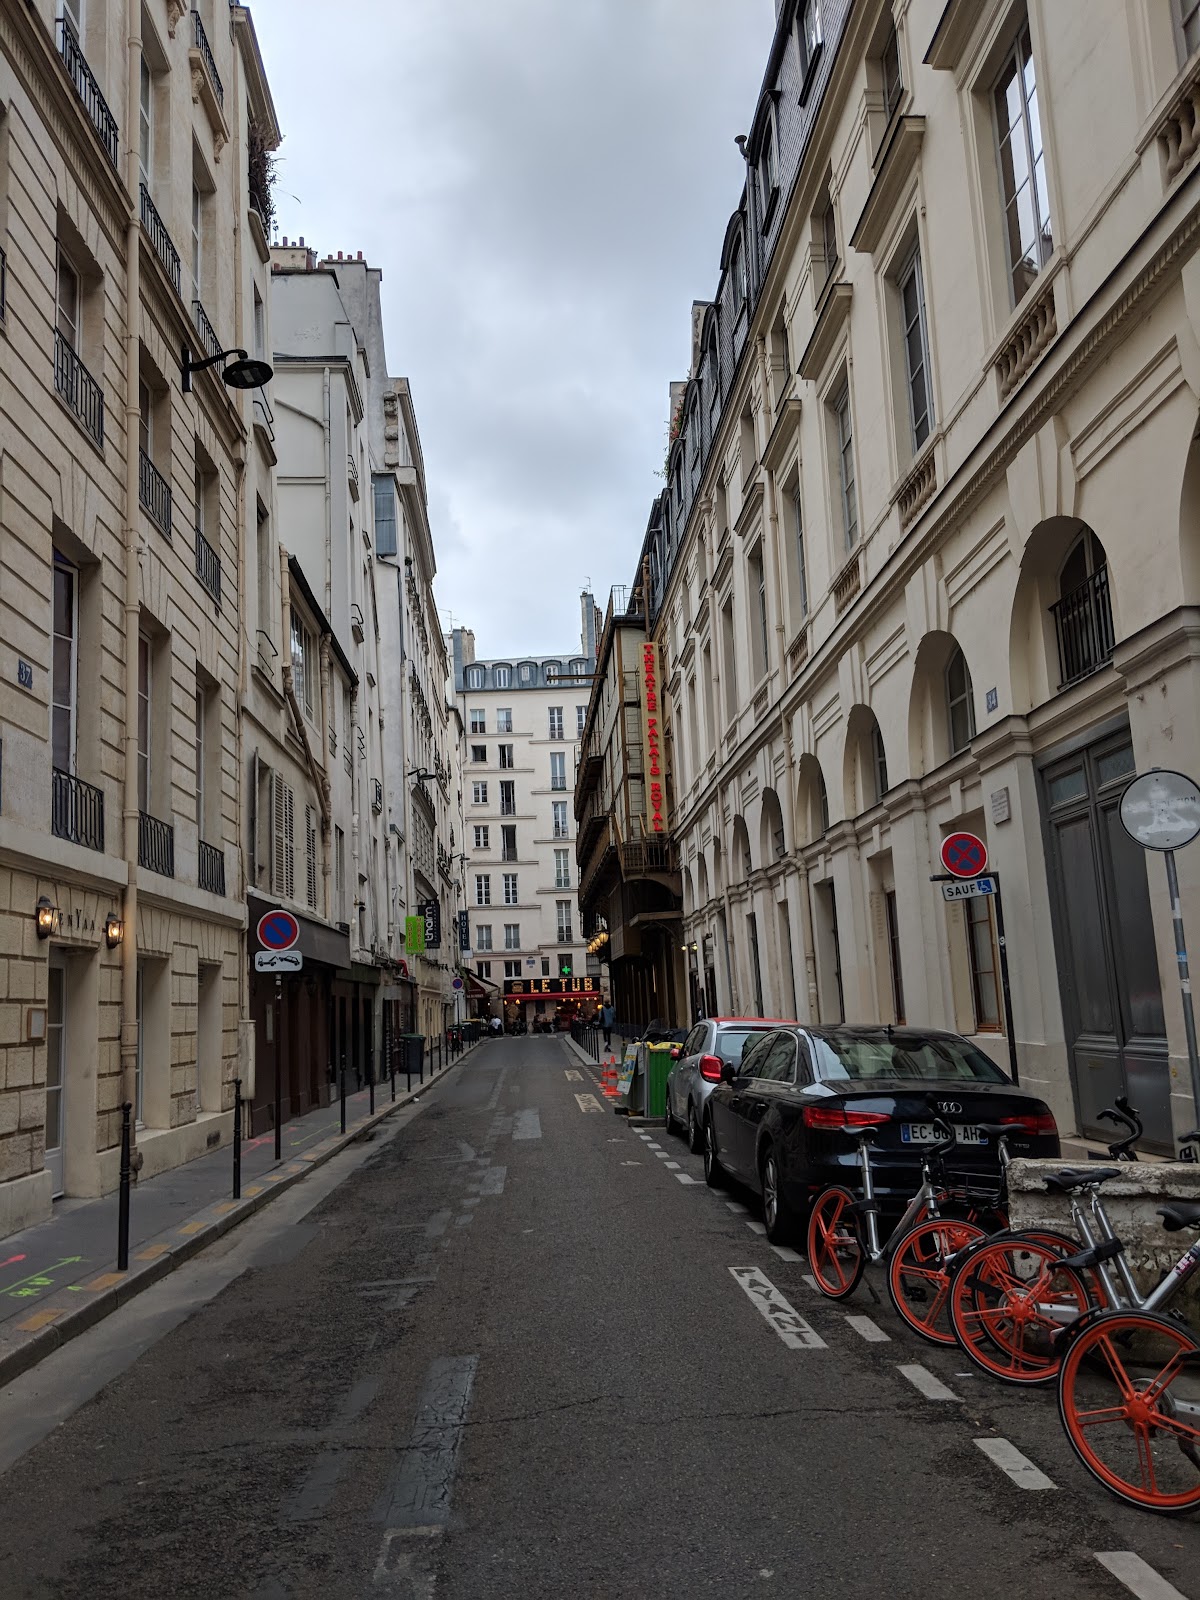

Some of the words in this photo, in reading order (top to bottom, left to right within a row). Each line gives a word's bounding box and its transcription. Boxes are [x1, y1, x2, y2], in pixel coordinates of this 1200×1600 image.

[20, 663, 31, 684] 37
[643, 644, 657, 712] THEATRE
[987, 691, 997, 710] 34
[647, 718, 661, 777] PALAIS
[650, 782, 664, 832] ROYAL
[946, 883, 976, 897] SAUF
[530, 979, 551, 994] LE
[559, 977, 593, 992] TUB
[733, 1268, 812, 1345] PAYANT
